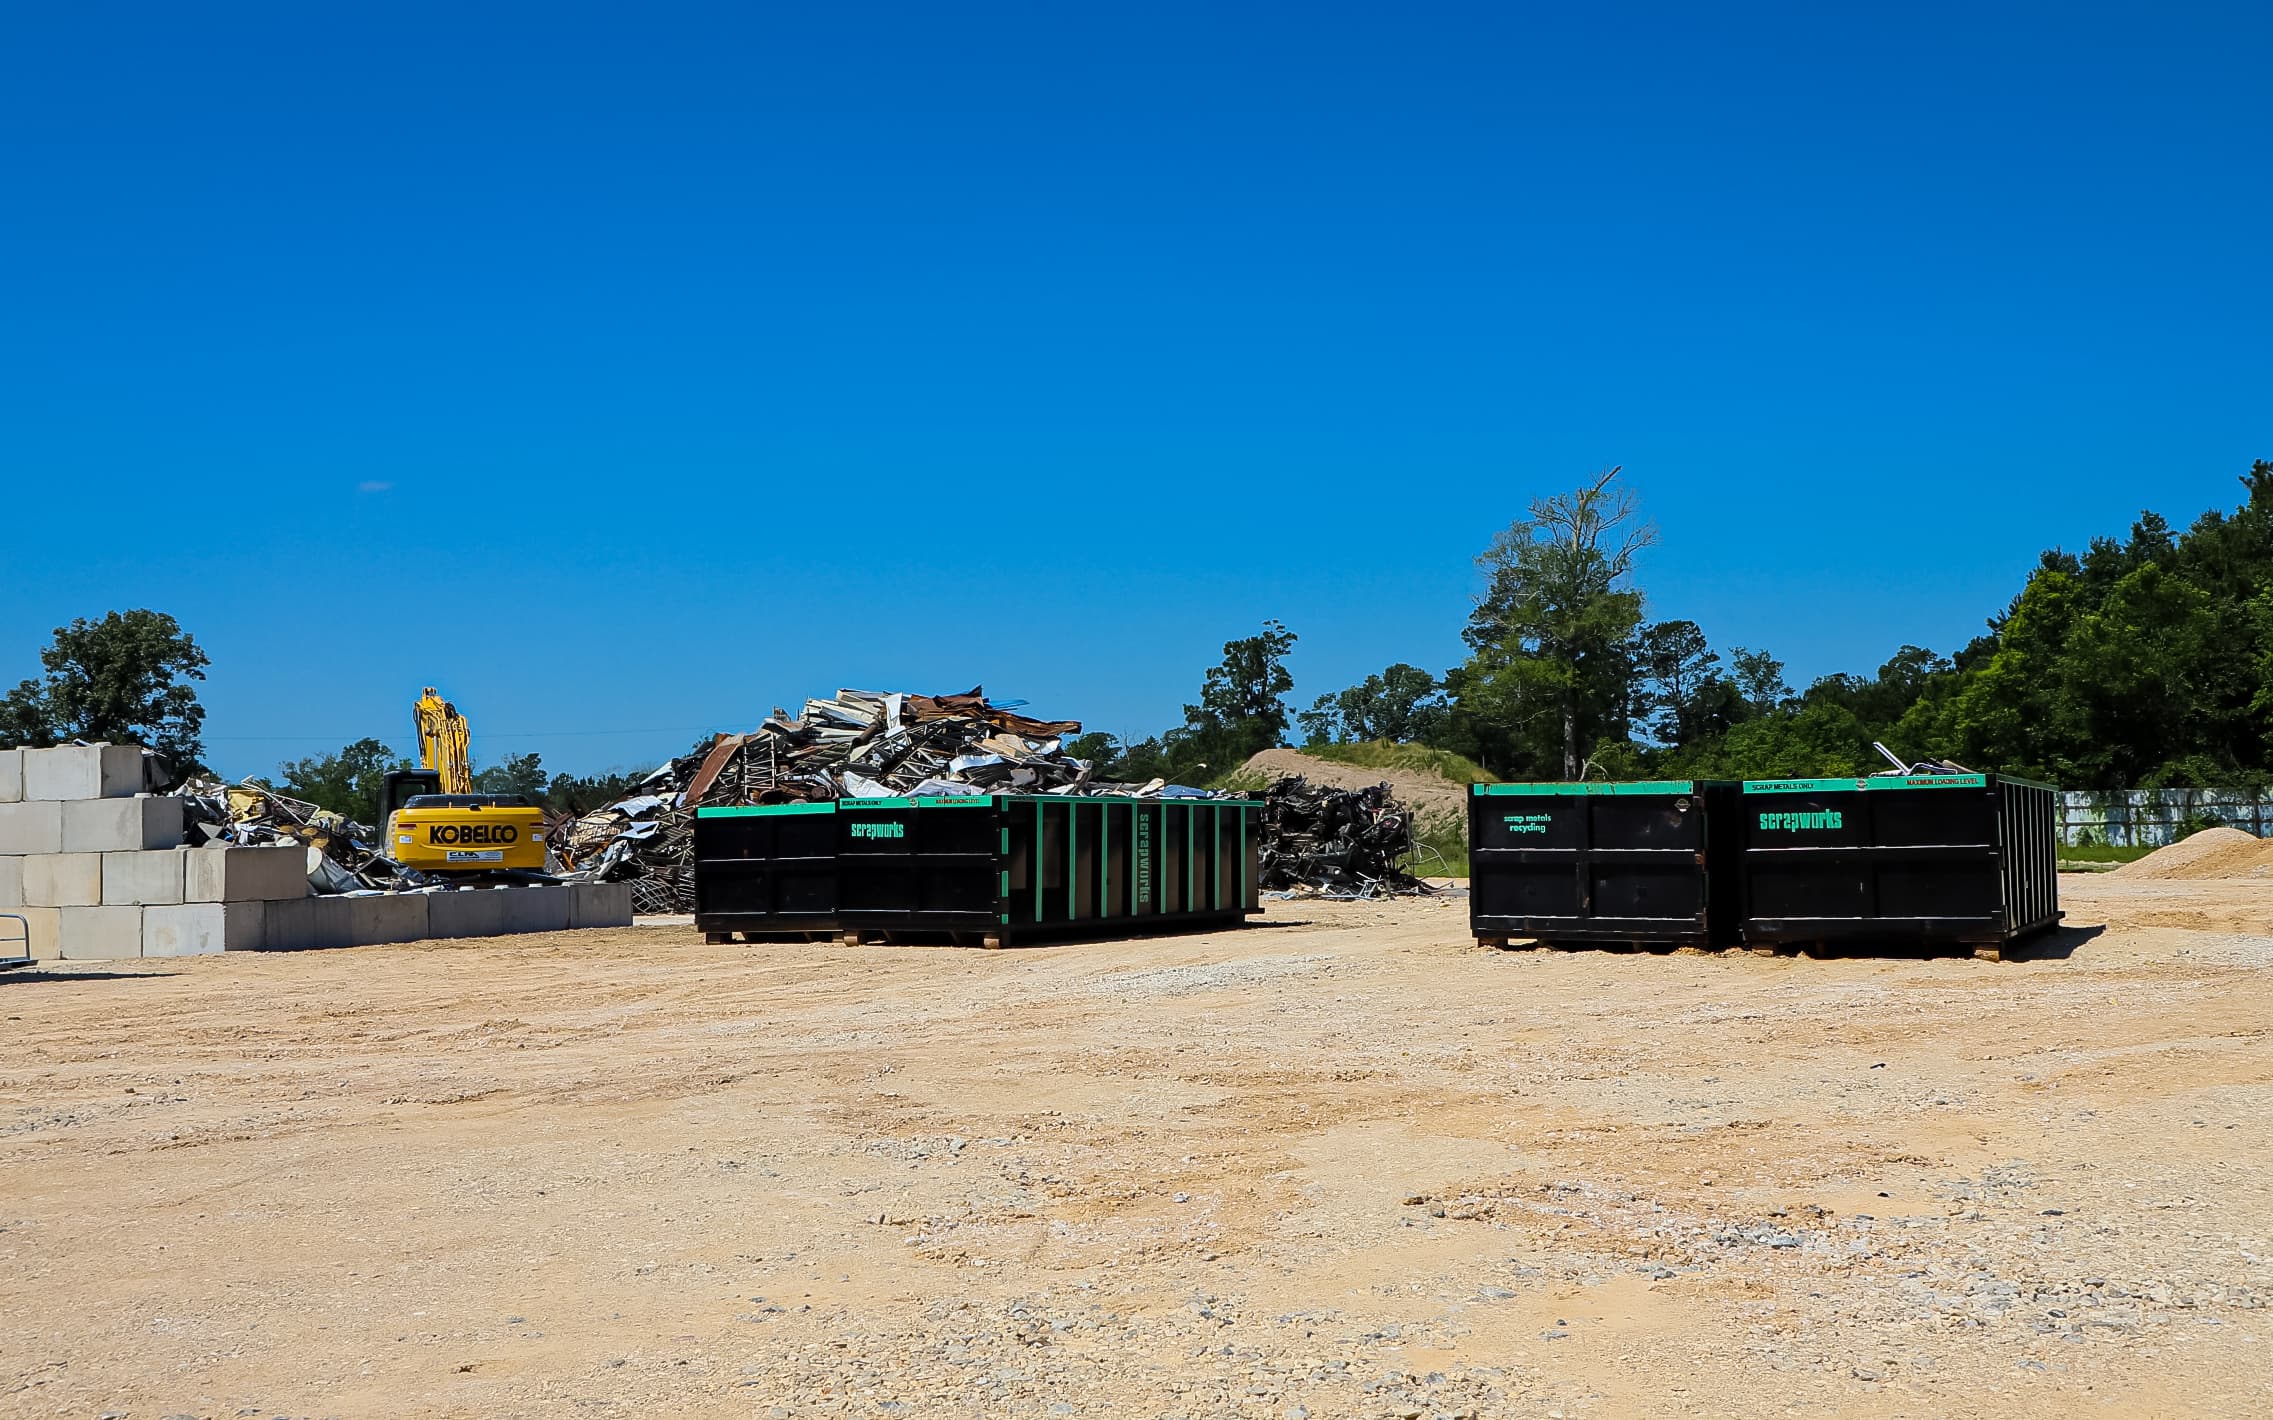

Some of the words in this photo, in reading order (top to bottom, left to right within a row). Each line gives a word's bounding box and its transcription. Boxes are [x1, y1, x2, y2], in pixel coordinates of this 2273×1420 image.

[1752, 783, 1773, 791] SCRAP
[1799, 782, 1814, 790] ONLY
[1504, 815, 1525, 824] scrap
[1526, 813, 1551, 822] metals
[1509, 822, 1546, 833] recycling
[1760, 808, 1842, 832] scrapworks
[429, 824, 518, 845] KOBELCO
[851, 821, 904, 840] scrapworks
[1139, 813, 1151, 903] scrapworks
